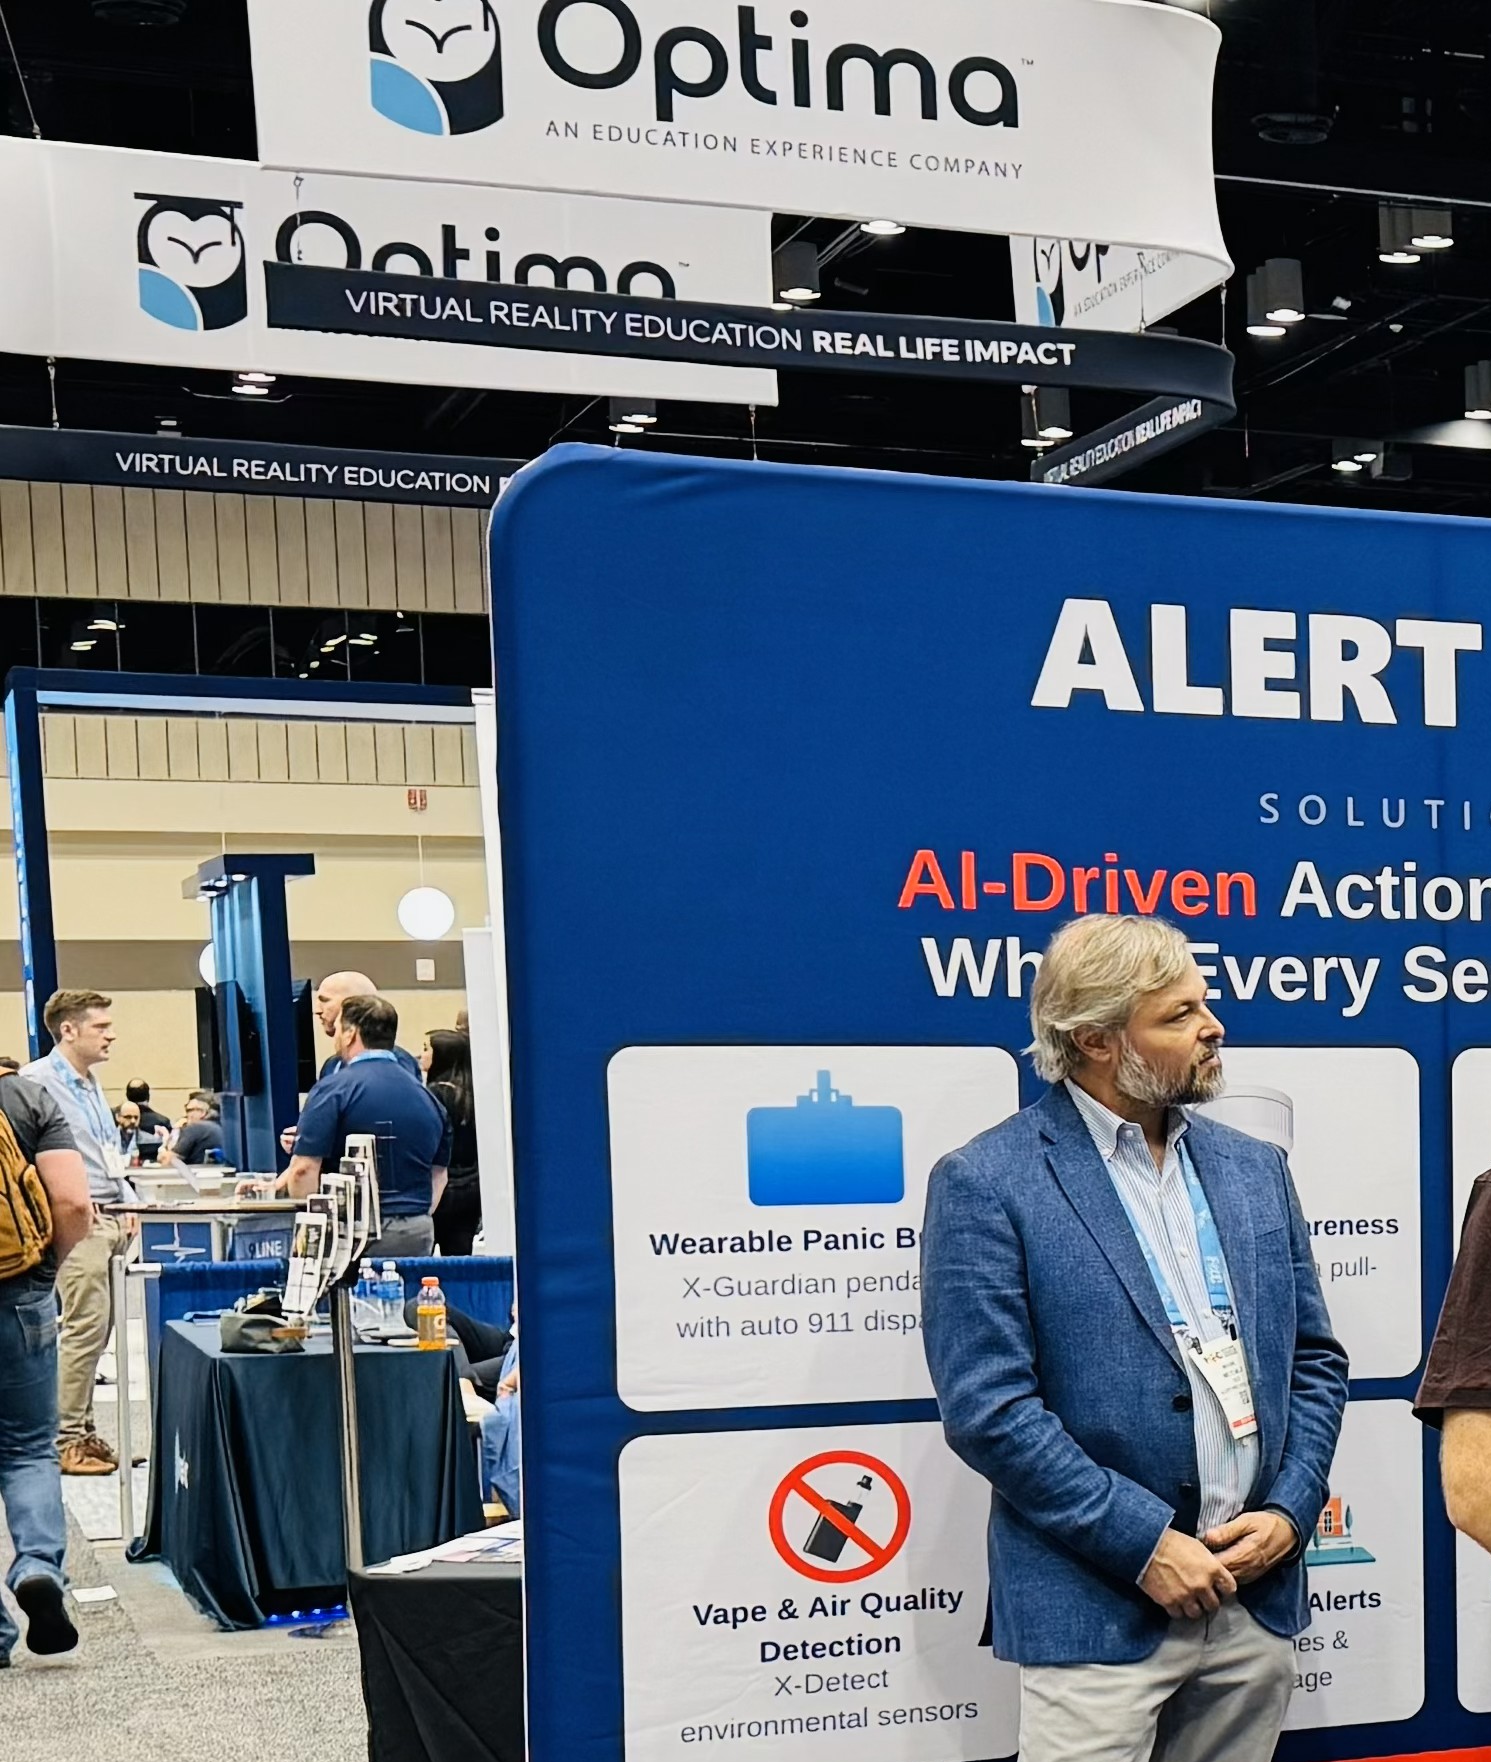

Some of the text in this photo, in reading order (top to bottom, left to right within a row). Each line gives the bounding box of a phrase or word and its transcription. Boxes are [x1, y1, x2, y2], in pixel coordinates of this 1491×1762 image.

[537, 0, 1019, 128] Optima
[546, 120, 1024, 180] AN EDUCATION EXPERIENCE COMPANY
[345, 289, 1076, 366] VIRTUAL REALITY EDUCATION REAL LIFE IMPACT
[115, 452, 227, 478] VIRTUAL
[232, 459, 339, 485] REALITY
[343, 466, 490, 494] EDUCATION
[1029, 596, 1483, 729] ALERT
[897, 848, 1258, 917] AI-Driven
[648, 1229, 793, 1256] Wearable
[803, 1226, 885, 1252] Panic
[681, 1273, 837, 1299] X-Guardian
[1330, 1255, 1377, 1282] pull-
[676, 1311, 854, 1338] with auto 911
[693, 1587, 964, 1630] Vape & Air Quality
[1309, 1590, 1382, 1612] Alerts
[759, 1632, 902, 1663] Detection
[1332, 1630, 1350, 1650] &
[773, 1669, 890, 1697] X-Detect
[680, 1701, 979, 1743] environmental sensors
